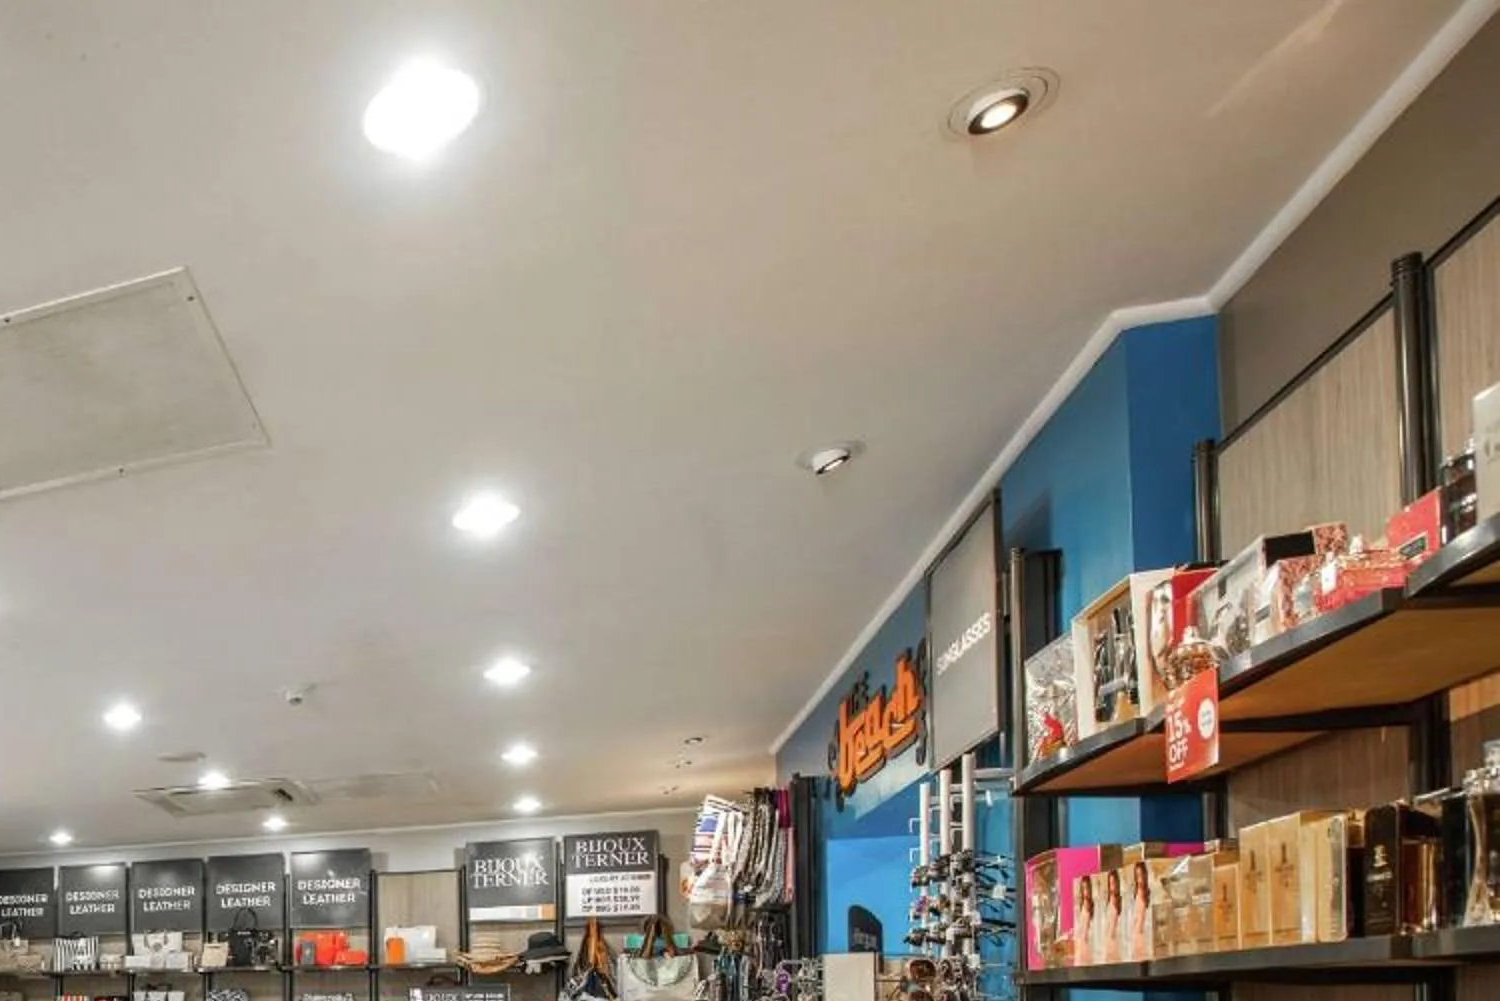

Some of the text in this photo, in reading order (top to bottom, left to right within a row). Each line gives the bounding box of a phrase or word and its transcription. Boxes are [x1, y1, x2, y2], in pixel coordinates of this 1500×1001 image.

[575, 837, 646, 853] BIJOUX
[474, 853, 545, 875] BIJOUX
[571, 850, 650, 869] TERNER
[297, 877, 362, 891] DESIGNER
[470, 869, 549, 889] TERNER
[138, 886, 196, 899] DESIGNER
[215, 881, 276, 895] DESIGNER
[65, 889, 120, 902] DESIGNER
[221, 895, 271, 909] LEATHER
[303, 892, 356, 905] LEATHER
[1, 907, 45, 917] LEATHER
[69, 903, 115, 915] LEATHER
[143, 900, 191, 912] LEATHER
